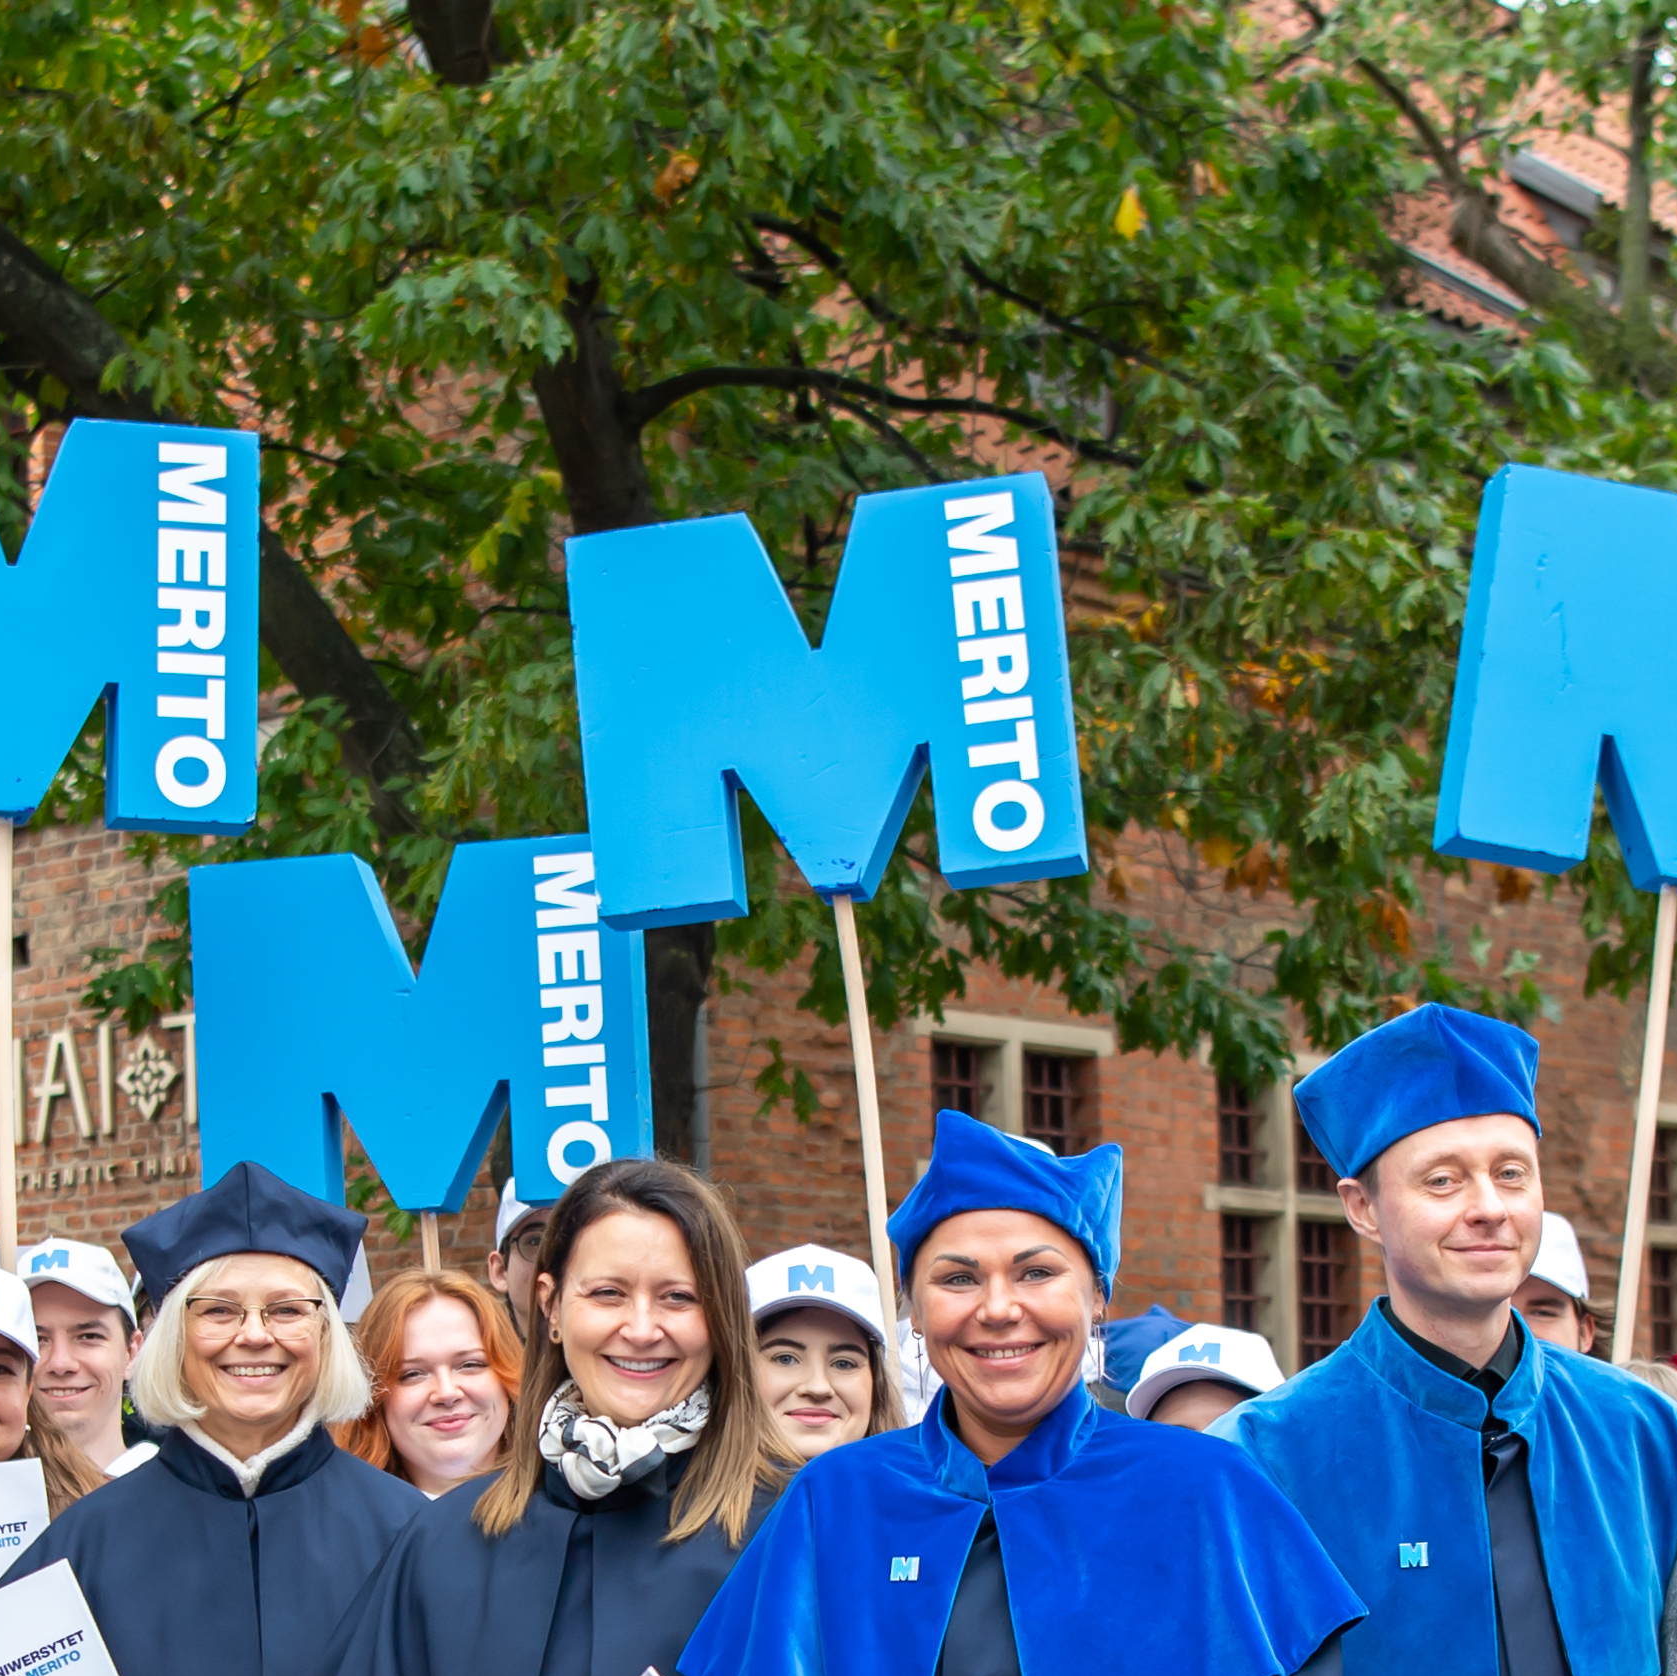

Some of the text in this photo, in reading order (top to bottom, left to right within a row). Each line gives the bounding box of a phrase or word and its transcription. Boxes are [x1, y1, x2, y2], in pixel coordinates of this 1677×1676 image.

[155, 441, 228, 808] MERITO
[943, 490, 1045, 852] MERITO
[131, 1155, 188, 1177] THAI
[533, 851, 612, 1186] MERITO
